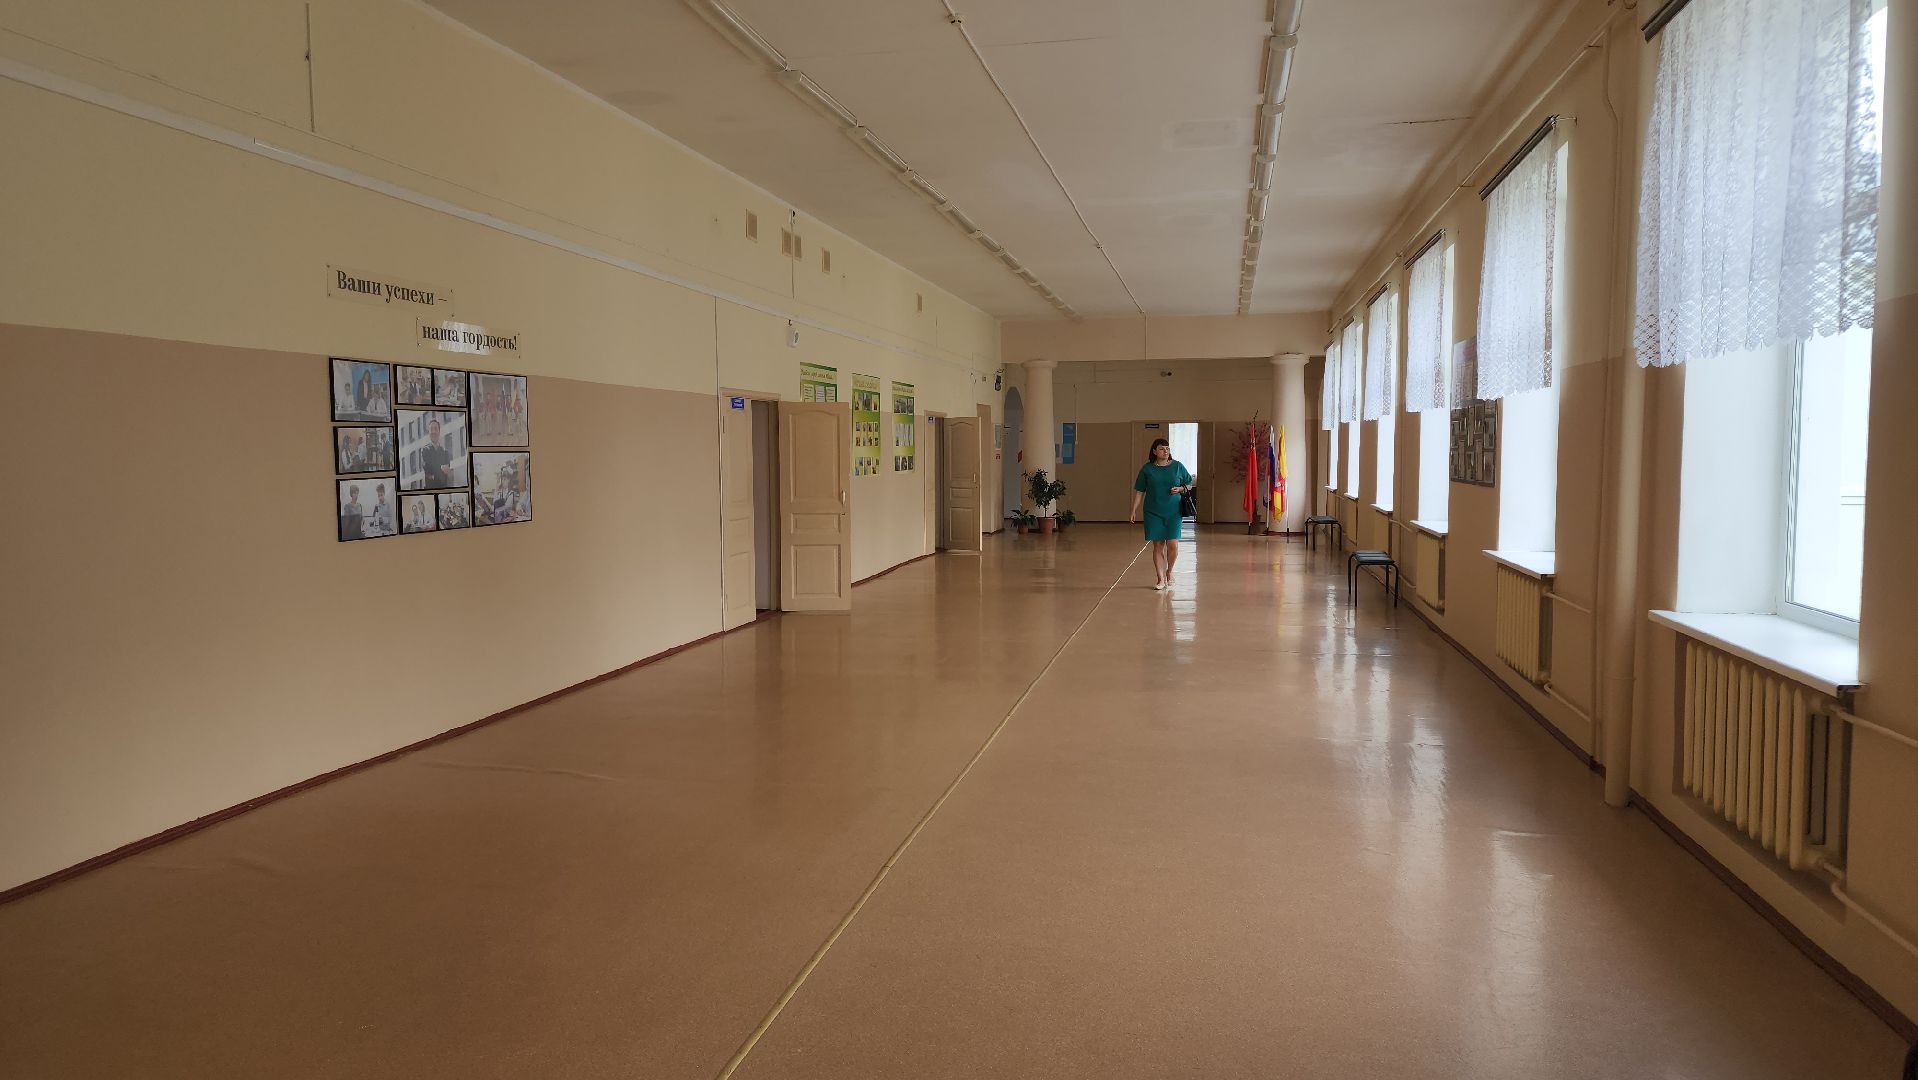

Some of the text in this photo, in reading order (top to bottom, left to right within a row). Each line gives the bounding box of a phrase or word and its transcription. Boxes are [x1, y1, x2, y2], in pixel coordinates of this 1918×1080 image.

[336, 270, 382, 296] Ваши
[384, 283, 435, 306] успехи
[421, 325, 518, 351] наша гордость!
